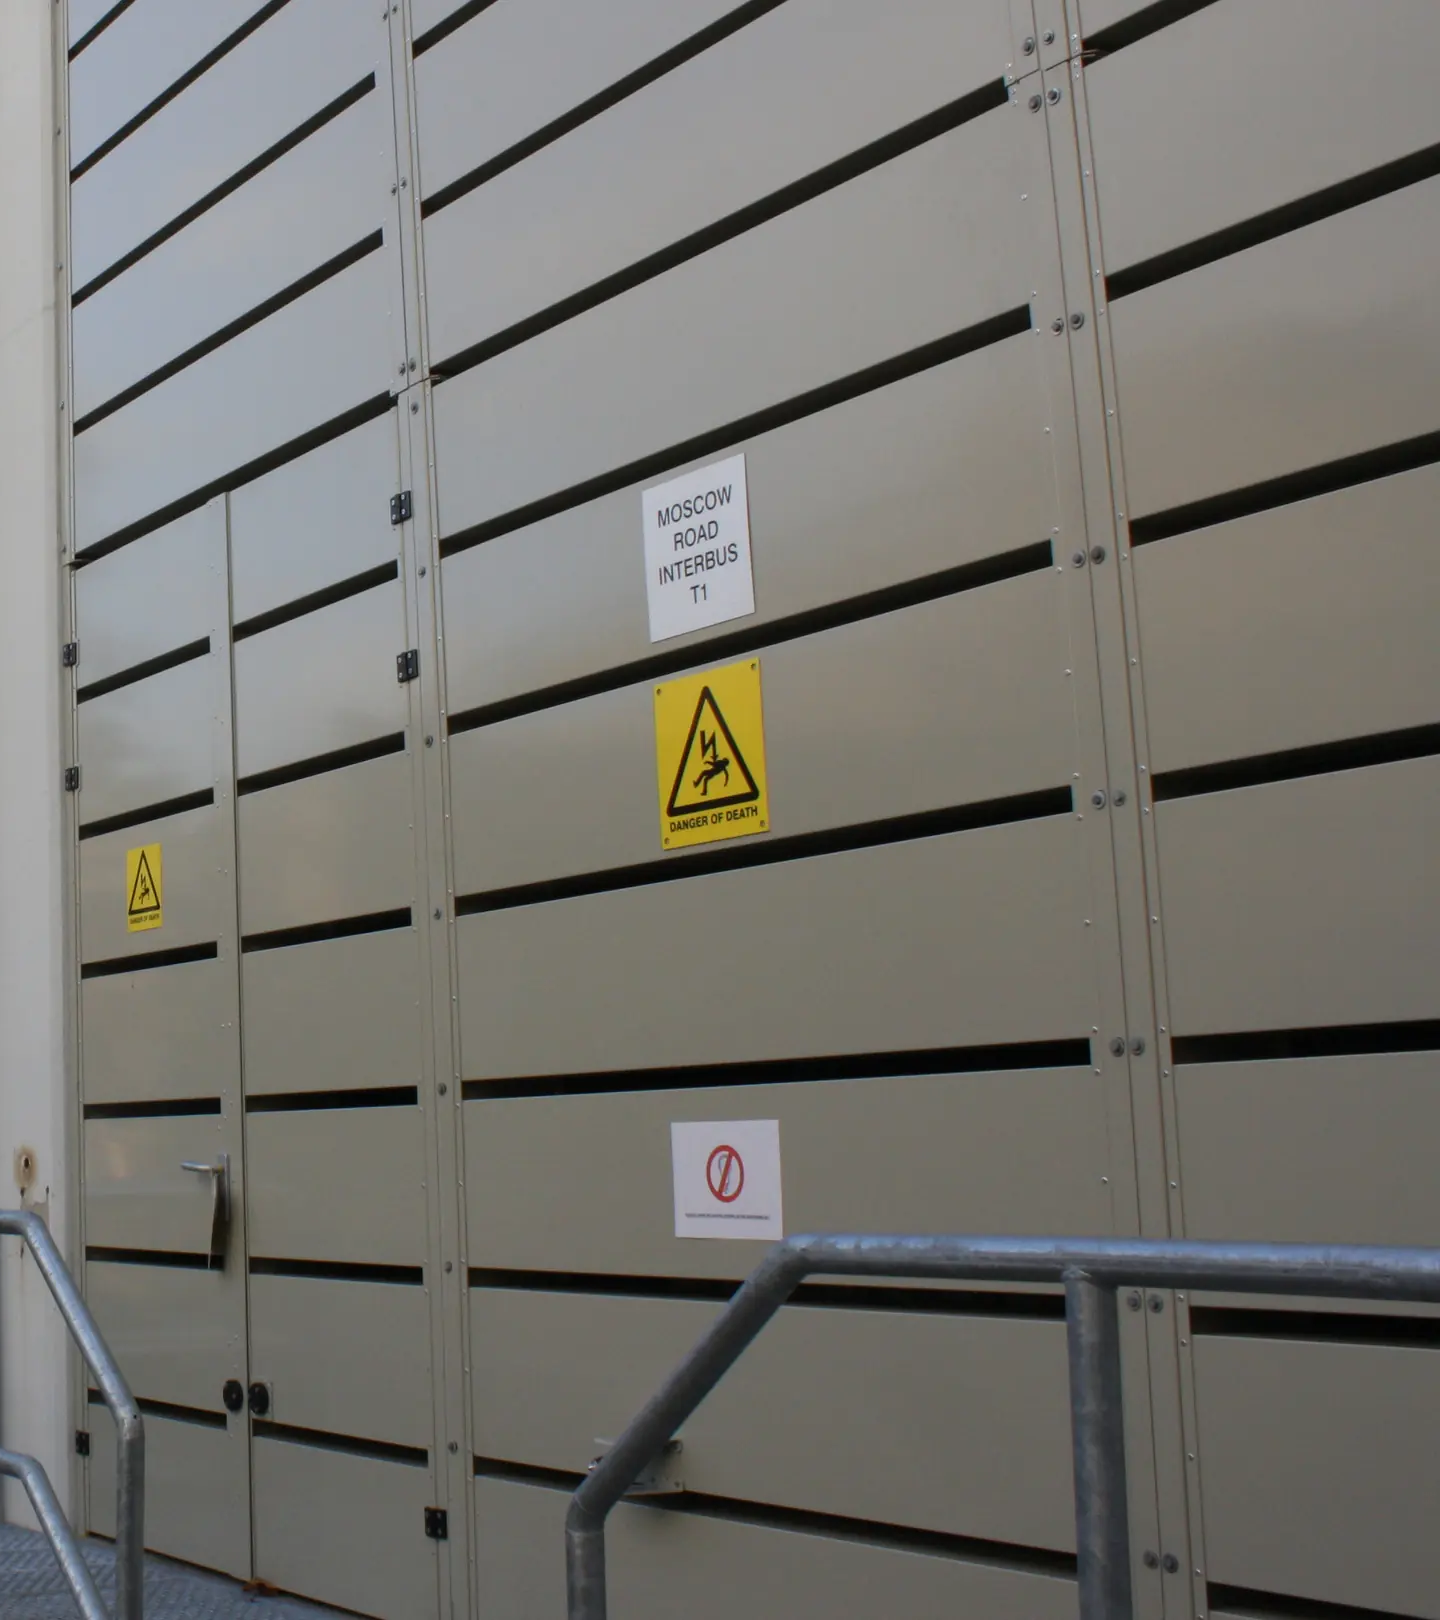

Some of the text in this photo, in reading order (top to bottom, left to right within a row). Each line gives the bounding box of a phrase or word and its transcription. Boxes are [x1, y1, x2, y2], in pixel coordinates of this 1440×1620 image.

[657, 484, 733, 529] MOSCOW
[673, 520, 719, 551] ROAD
[658, 543, 739, 585] INTERBUS
[690, 583, 708, 604] T1
[669, 806, 758, 833] DANGER OF DEATH
